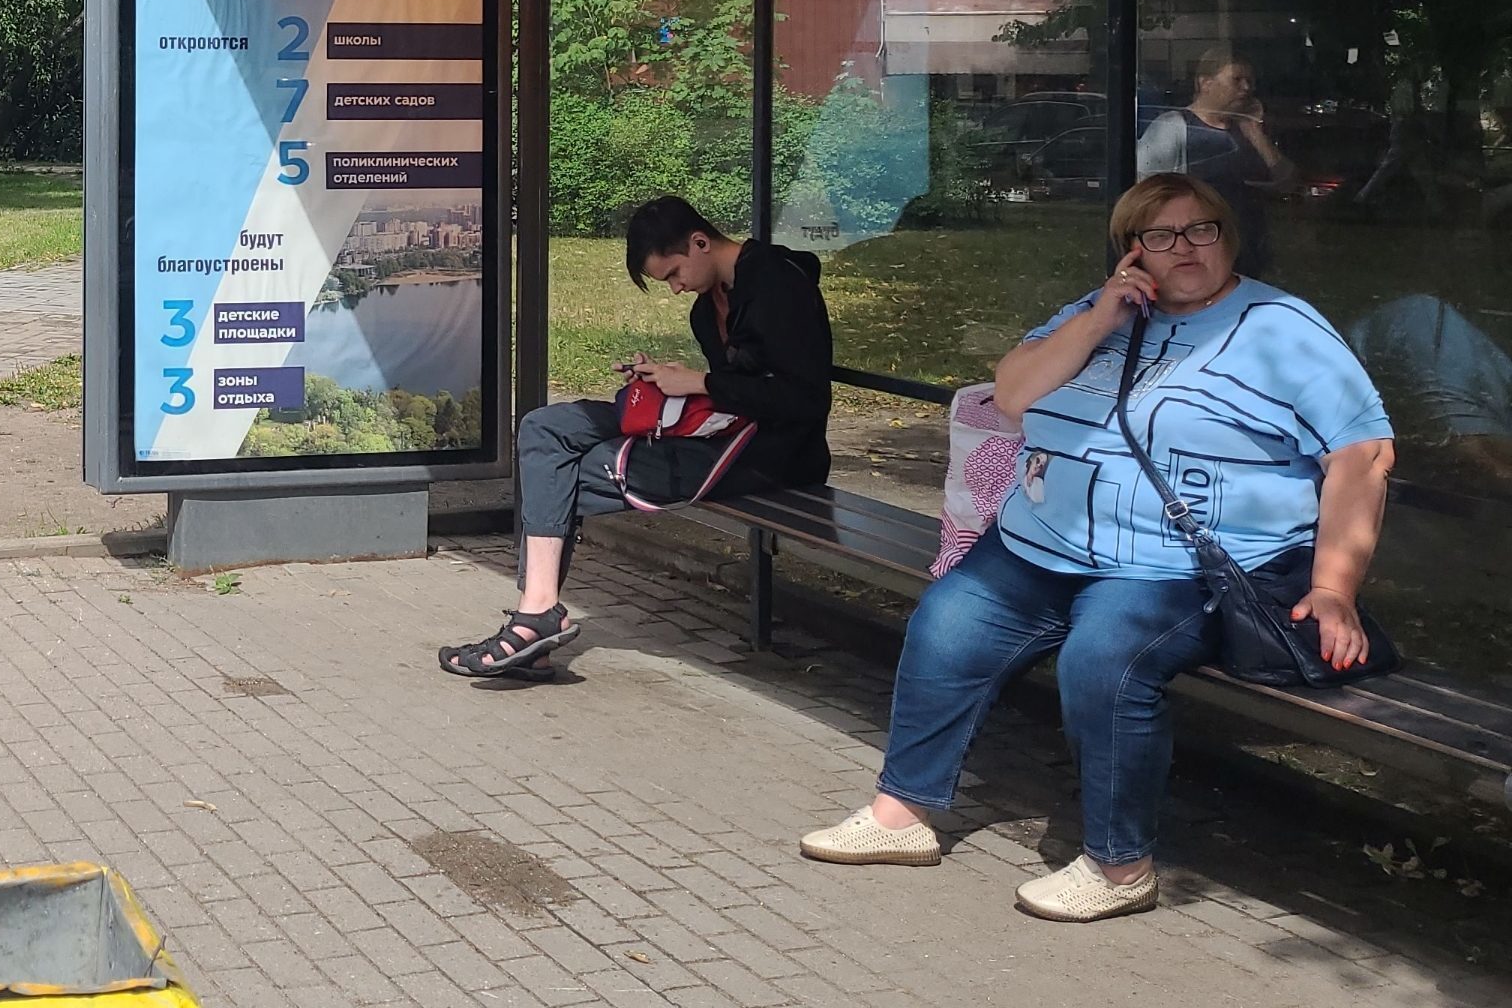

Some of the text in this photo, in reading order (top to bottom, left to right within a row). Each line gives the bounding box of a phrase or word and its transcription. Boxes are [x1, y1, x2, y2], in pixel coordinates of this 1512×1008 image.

[159, 35, 249, 51] откроются
[276, 16, 381, 61] 2 школы
[276, 78, 435, 123] 7 детских садов
[276, 141, 310, 186] 5
[333, 154, 459, 168] поликлинических
[333, 170, 407, 184] отделений
[240, 229, 284, 249] будут
[157, 256, 284, 276] благоустроены
[160, 299, 279, 347] 3 детские
[218, 325, 296, 340] площадки
[160, 368, 257, 415] 3 зоны
[218, 391, 275, 405] отдыха
